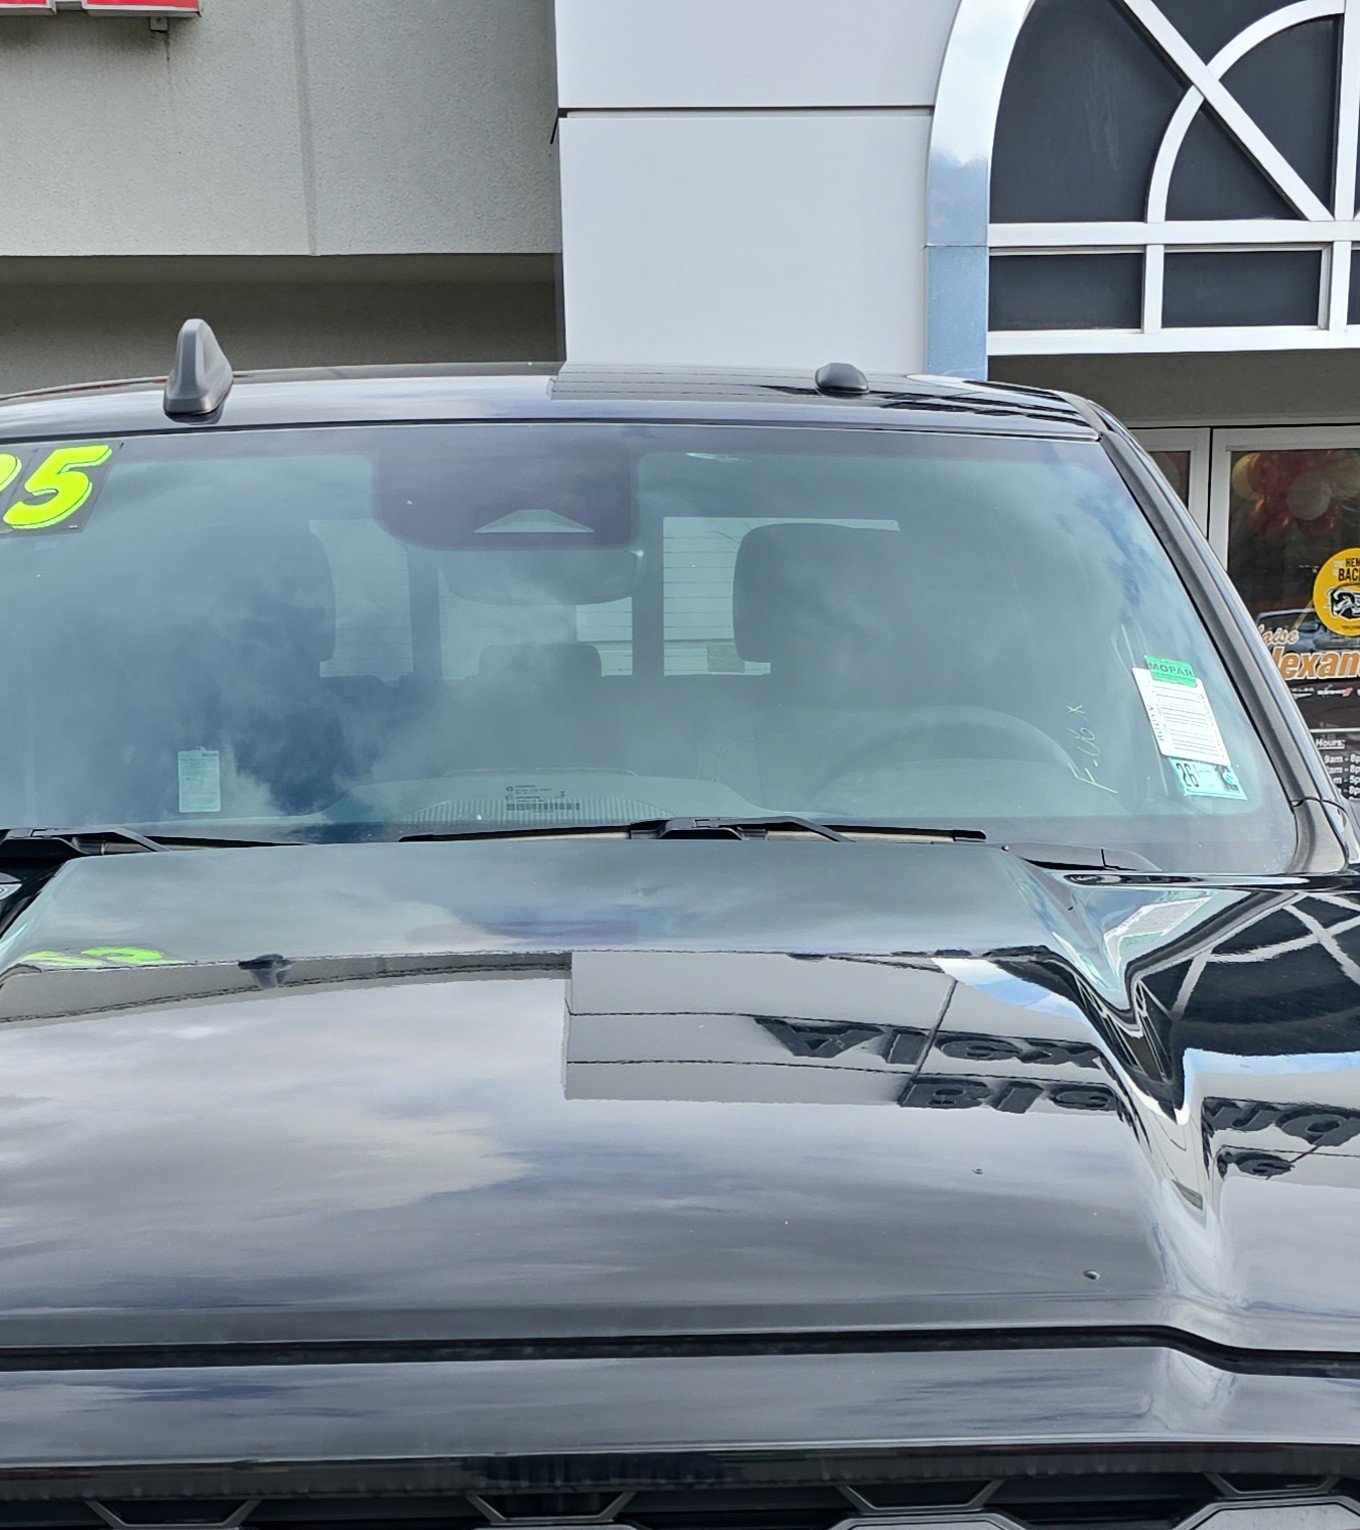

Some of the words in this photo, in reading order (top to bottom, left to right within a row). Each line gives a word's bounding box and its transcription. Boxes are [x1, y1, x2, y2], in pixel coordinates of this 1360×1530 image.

[1257, 623, 1300, 645] laise
[1147, 662, 1194, 677] MOPAR
[1175, 762, 1200, 788] 26
